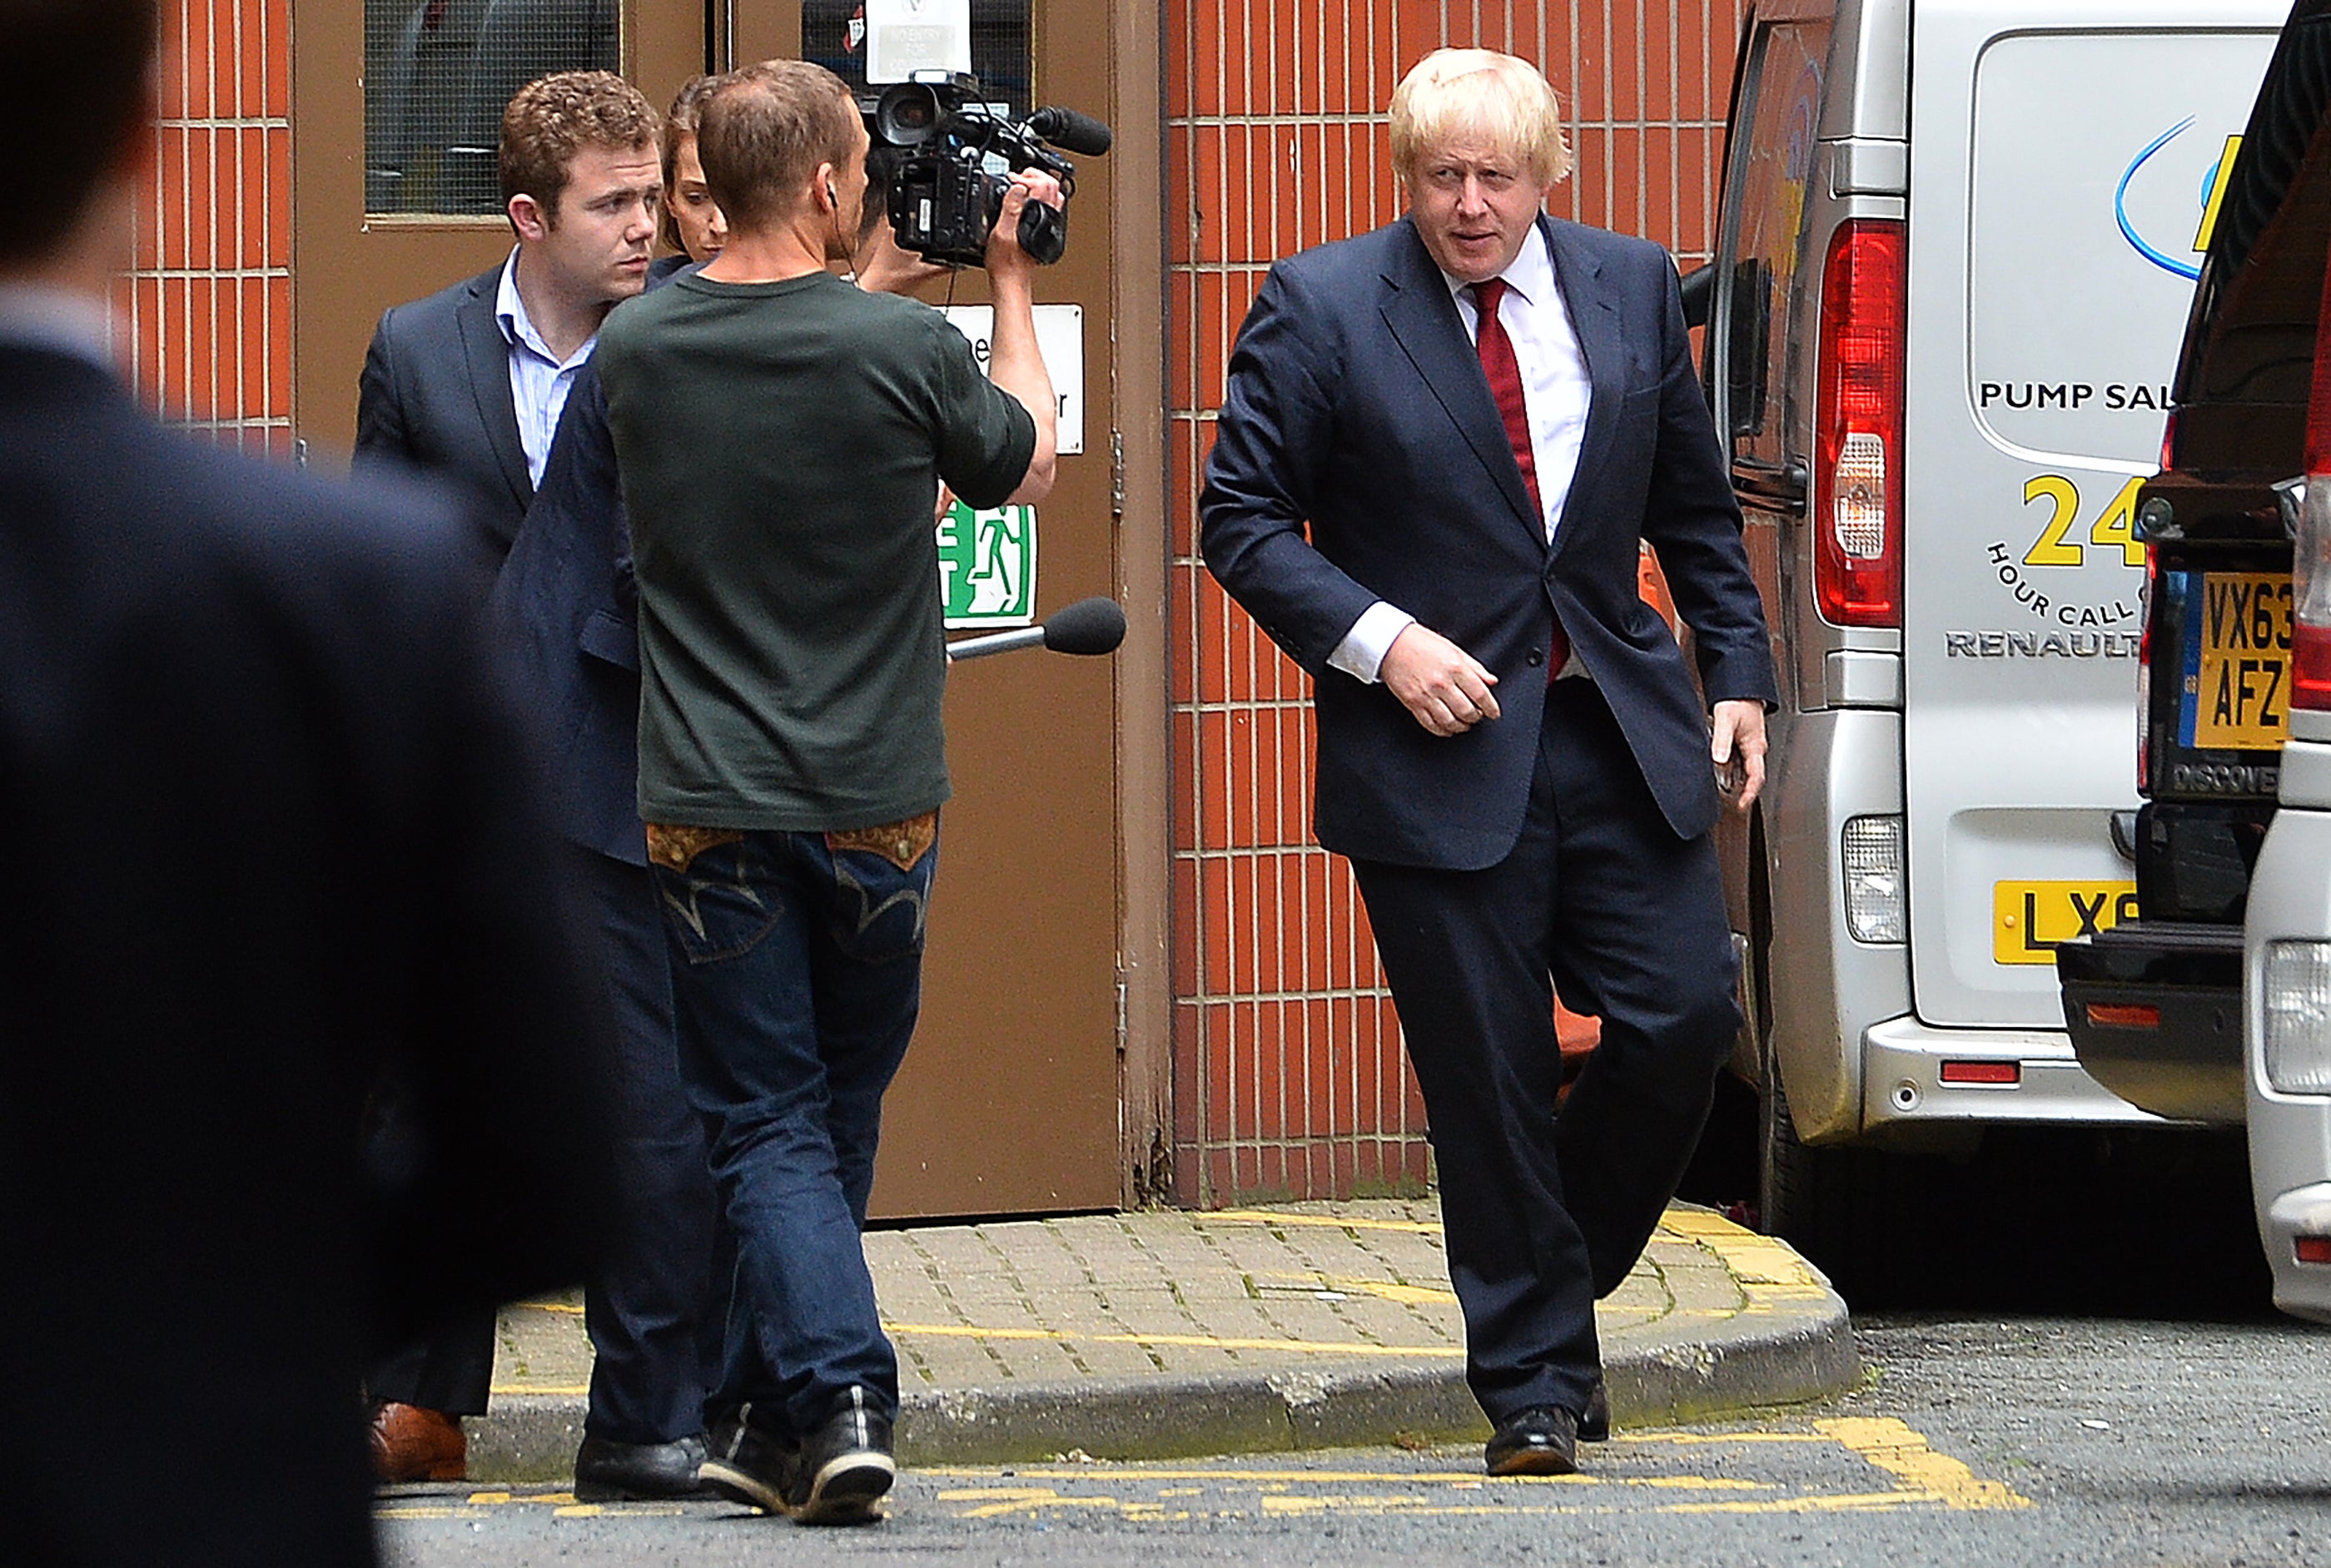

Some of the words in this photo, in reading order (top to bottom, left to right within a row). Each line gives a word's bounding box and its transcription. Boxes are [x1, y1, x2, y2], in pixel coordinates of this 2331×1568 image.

[1981, 384, 2093, 409] PUMP
[2105, 384, 2173, 409] SAL
[2024, 475, 2146, 565] 24
[1987, 543, 2050, 618] HOUR
[2058, 602, 2134, 626] CALL
[2209, 583, 2292, 649] VX63
[1946, 631, 2141, 657] RENAULT
[2213, 658, 2283, 727] AFZ
